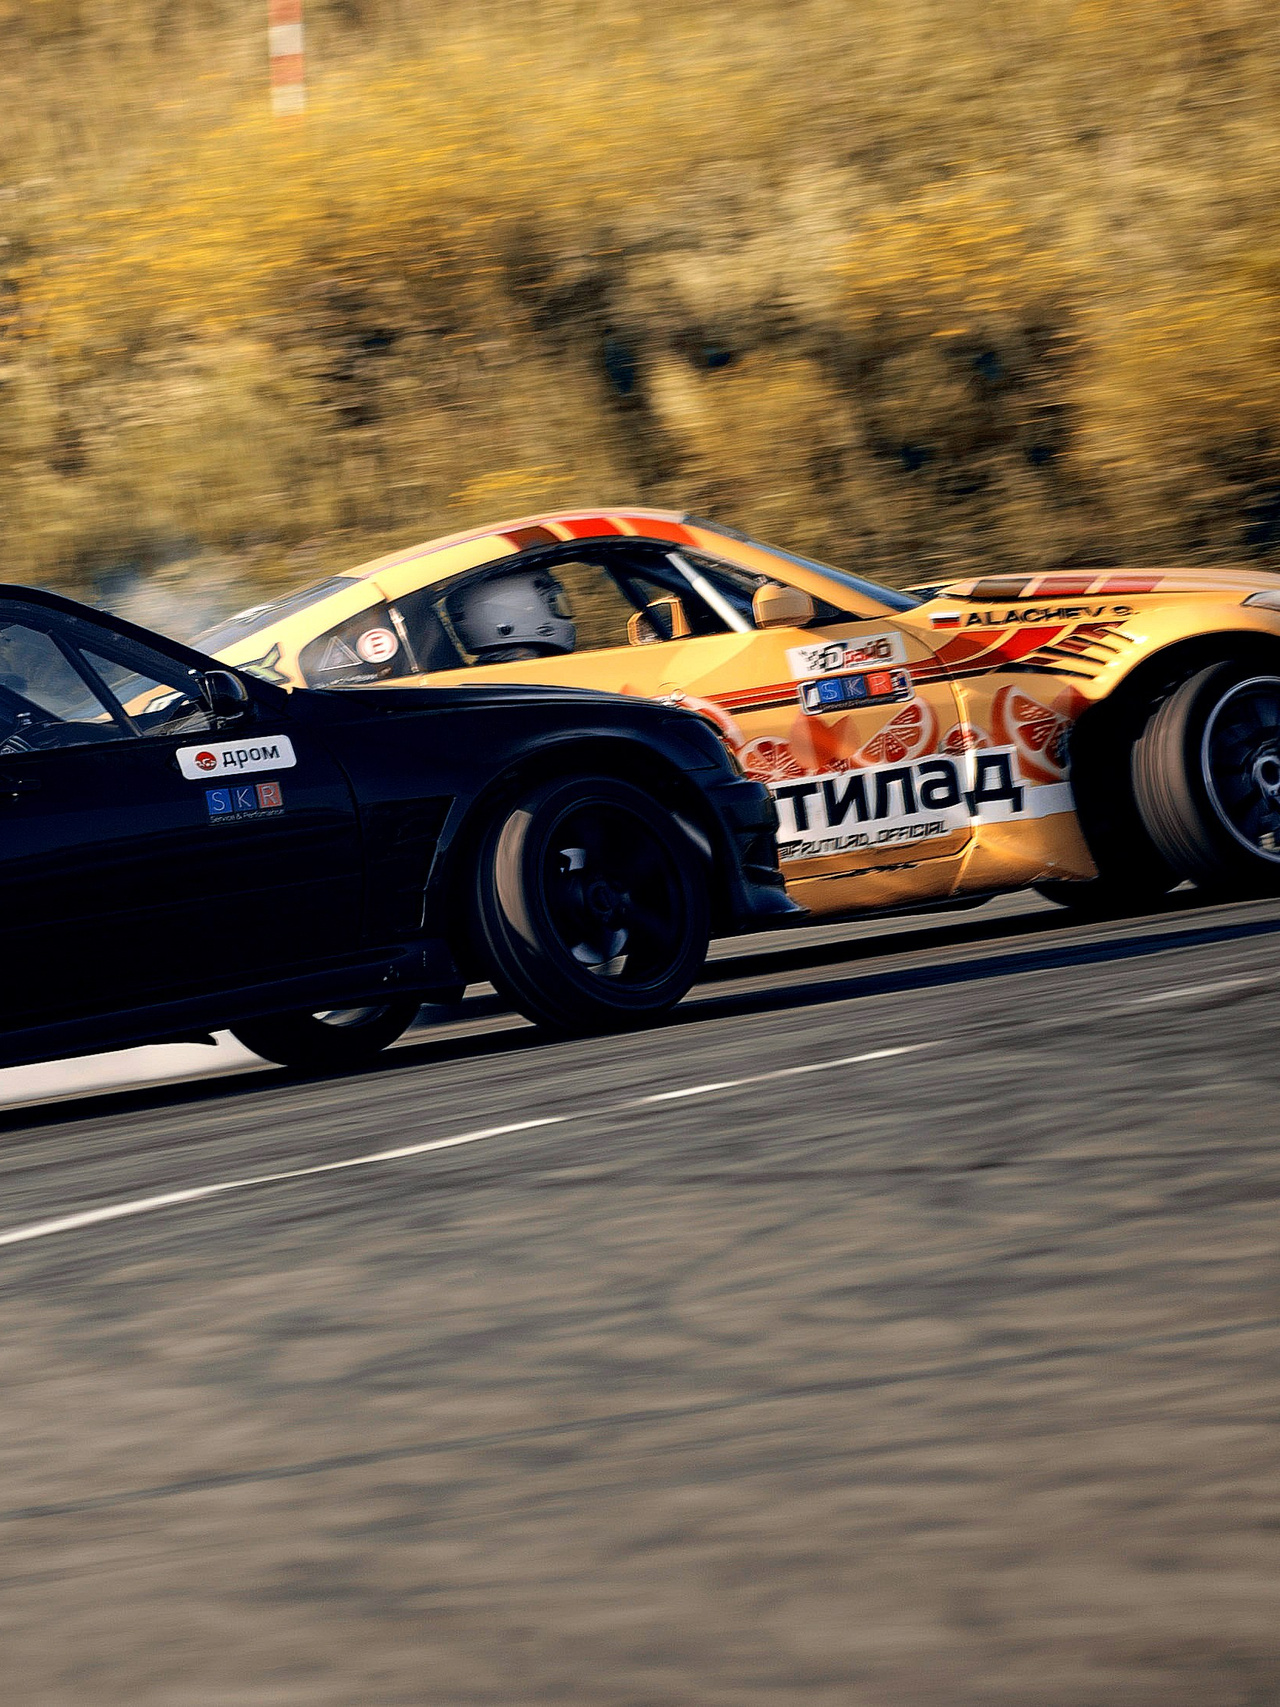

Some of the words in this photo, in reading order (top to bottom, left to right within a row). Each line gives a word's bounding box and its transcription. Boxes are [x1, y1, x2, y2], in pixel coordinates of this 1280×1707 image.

[966, 605, 1107, 627] ALACHEV
[821, 675, 890, 700] SKR
[222, 745, 280, 769] дром
[210, 785, 279, 812] SKR
[775, 752, 1025, 832] тилад
